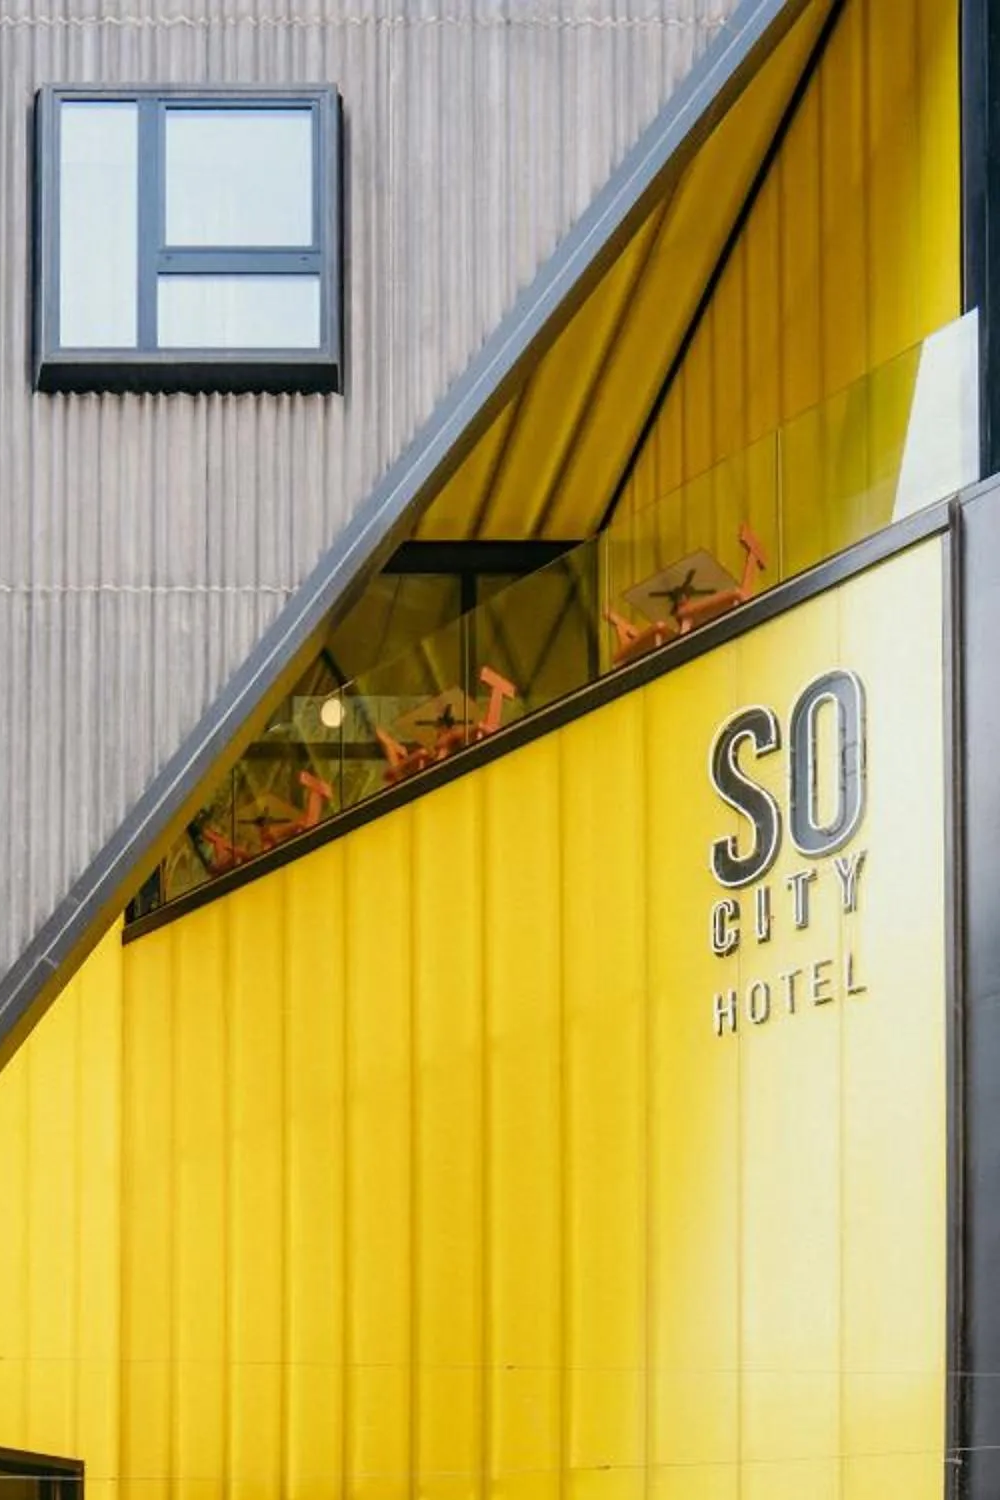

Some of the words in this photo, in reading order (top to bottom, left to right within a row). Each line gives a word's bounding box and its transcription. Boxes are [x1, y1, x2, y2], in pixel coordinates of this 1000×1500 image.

[709, 667, 867, 888] SO
[711, 850, 867, 957] CITY
[713, 950, 867, 1036] HOTEL
